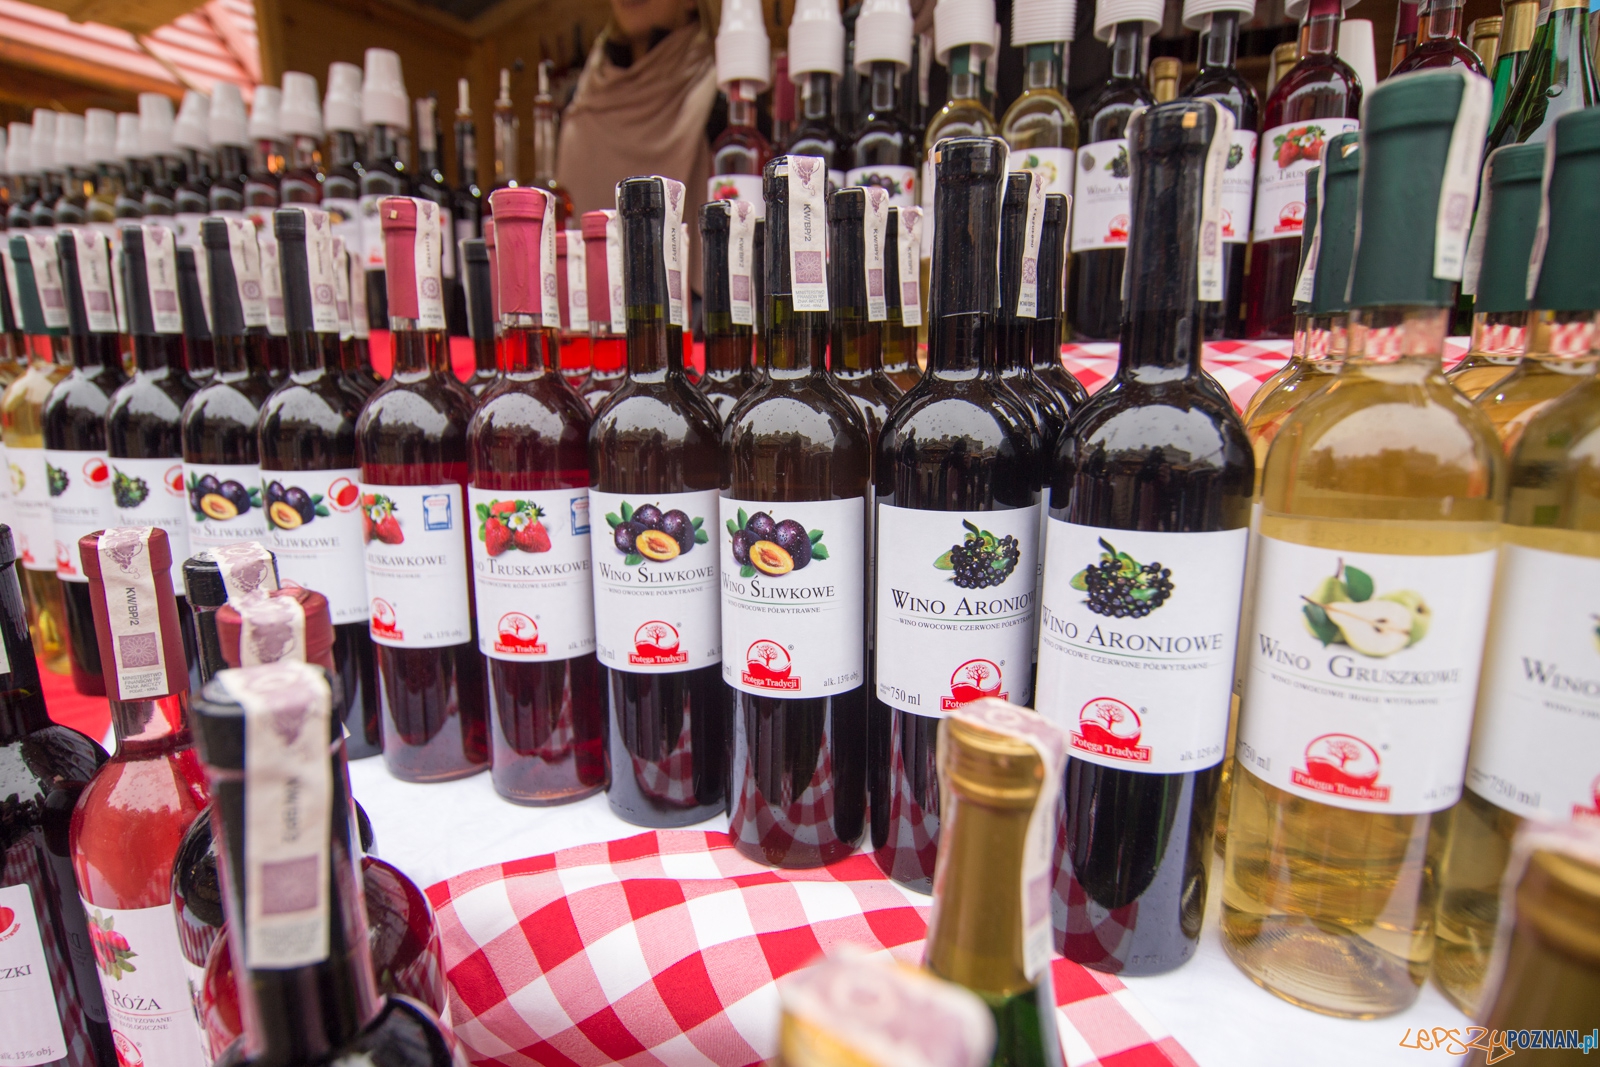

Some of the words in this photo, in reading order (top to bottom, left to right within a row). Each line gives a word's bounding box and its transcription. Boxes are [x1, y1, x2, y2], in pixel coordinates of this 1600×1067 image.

[804, 203, 812, 242] KW/BP/2
[204, 522, 264, 538] ŚLIWKOW
[487, 558, 590, 576] TRUSKAWKOWE
[598, 562, 631, 582] WINO
[638, 562, 714, 583] ŚLIWKOWE
[722, 571, 745, 595] WINO
[751, 575, 835, 599] ŚLIWKOWE
[125, 586, 140, 626] KW/BP/2
[767, 606, 820, 614] PÓŁWYTRAWNE
[891, 588, 946, 615] WINO
[954, 590, 1036, 616] ARONIOW
[917, 621, 958, 631] OWOCOWE
[960, 623, 1000, 632] CZERWONE
[1042, 604, 1078, 639] WINO
[1086, 624, 1223, 653] ARONIOWE
[631, 655, 654, 664] Potęga
[655, 653, 685, 664] Tradycji
[1091, 655, 1141, 669] CZERWONE
[1258, 633, 1311, 671] WINO
[1328, 655, 1462, 685] GRUSZKOWE
[743, 674, 765, 687] Potęga
[766, 677, 797, 689] Tradycji
[823, 676, 836, 687] alk.
[890, 686, 906, 702] 750
[907, 693, 921, 706] ml
[1072, 735, 1103, 753] Potęga
[1104, 744, 1147, 760] Tradycji
[1256, 756, 1271, 771] ml
[111, 989, 162, 1011] RÓŻA
[15, 1050, 34, 1060] 13%
[36, 1045, 55, 1058] obj.
